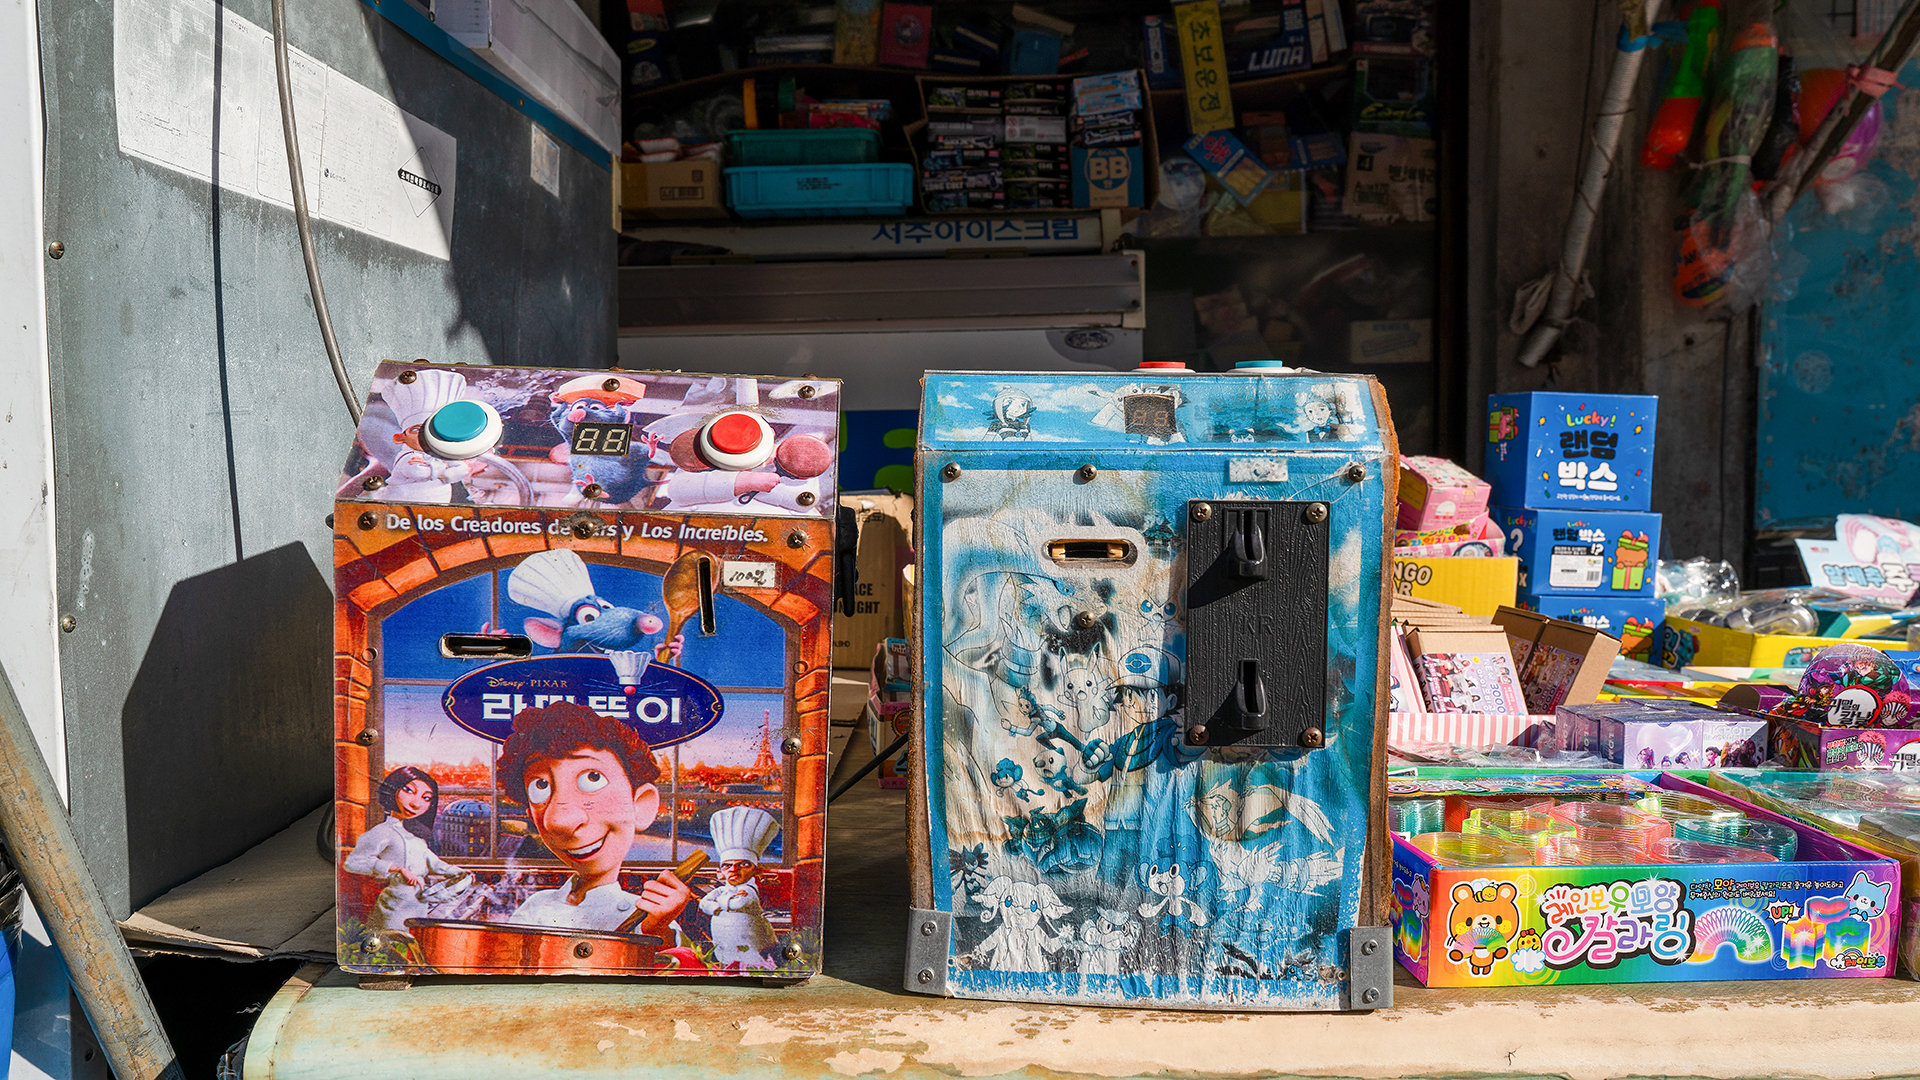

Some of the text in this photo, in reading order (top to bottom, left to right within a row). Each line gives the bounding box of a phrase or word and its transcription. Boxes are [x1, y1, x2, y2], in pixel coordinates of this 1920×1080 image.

[1191, 21, 1221, 112] 초보운전
[1247, 46, 1304, 71] LUNA
[1090, 156, 1128, 180] BB
[872, 219, 1078, 243] 서주아이스크림
[1567, 410, 1616, 427] Lucky!
[1560, 430, 1618, 460] 랜덤
[1558, 461, 1617, 491] 박스
[386, 514, 410, 530] De
[417, 514, 445, 531] los
[451, 516, 541, 534] Creadores
[622, 525, 634, 540] y
[642, 523, 672, 539] Los
[679, 524, 768, 542] Increíbles.
[729, 570, 767, 585] 100원
[486, 677, 568, 690] Disney PIXAR
[1476, 669, 1495, 715] 아이브비공
[1490, 683, 1506, 714] 3000
[1714, 878, 1735, 891] 모양
[1736, 882, 1760, 890] 레인보우
[1794, 880, 1813, 890] 즐거운
[1771, 906, 1794, 919] UP!
[1544, 913, 1687, 960] 칼라링
[1844, 955, 1886, 969] 레인보우
